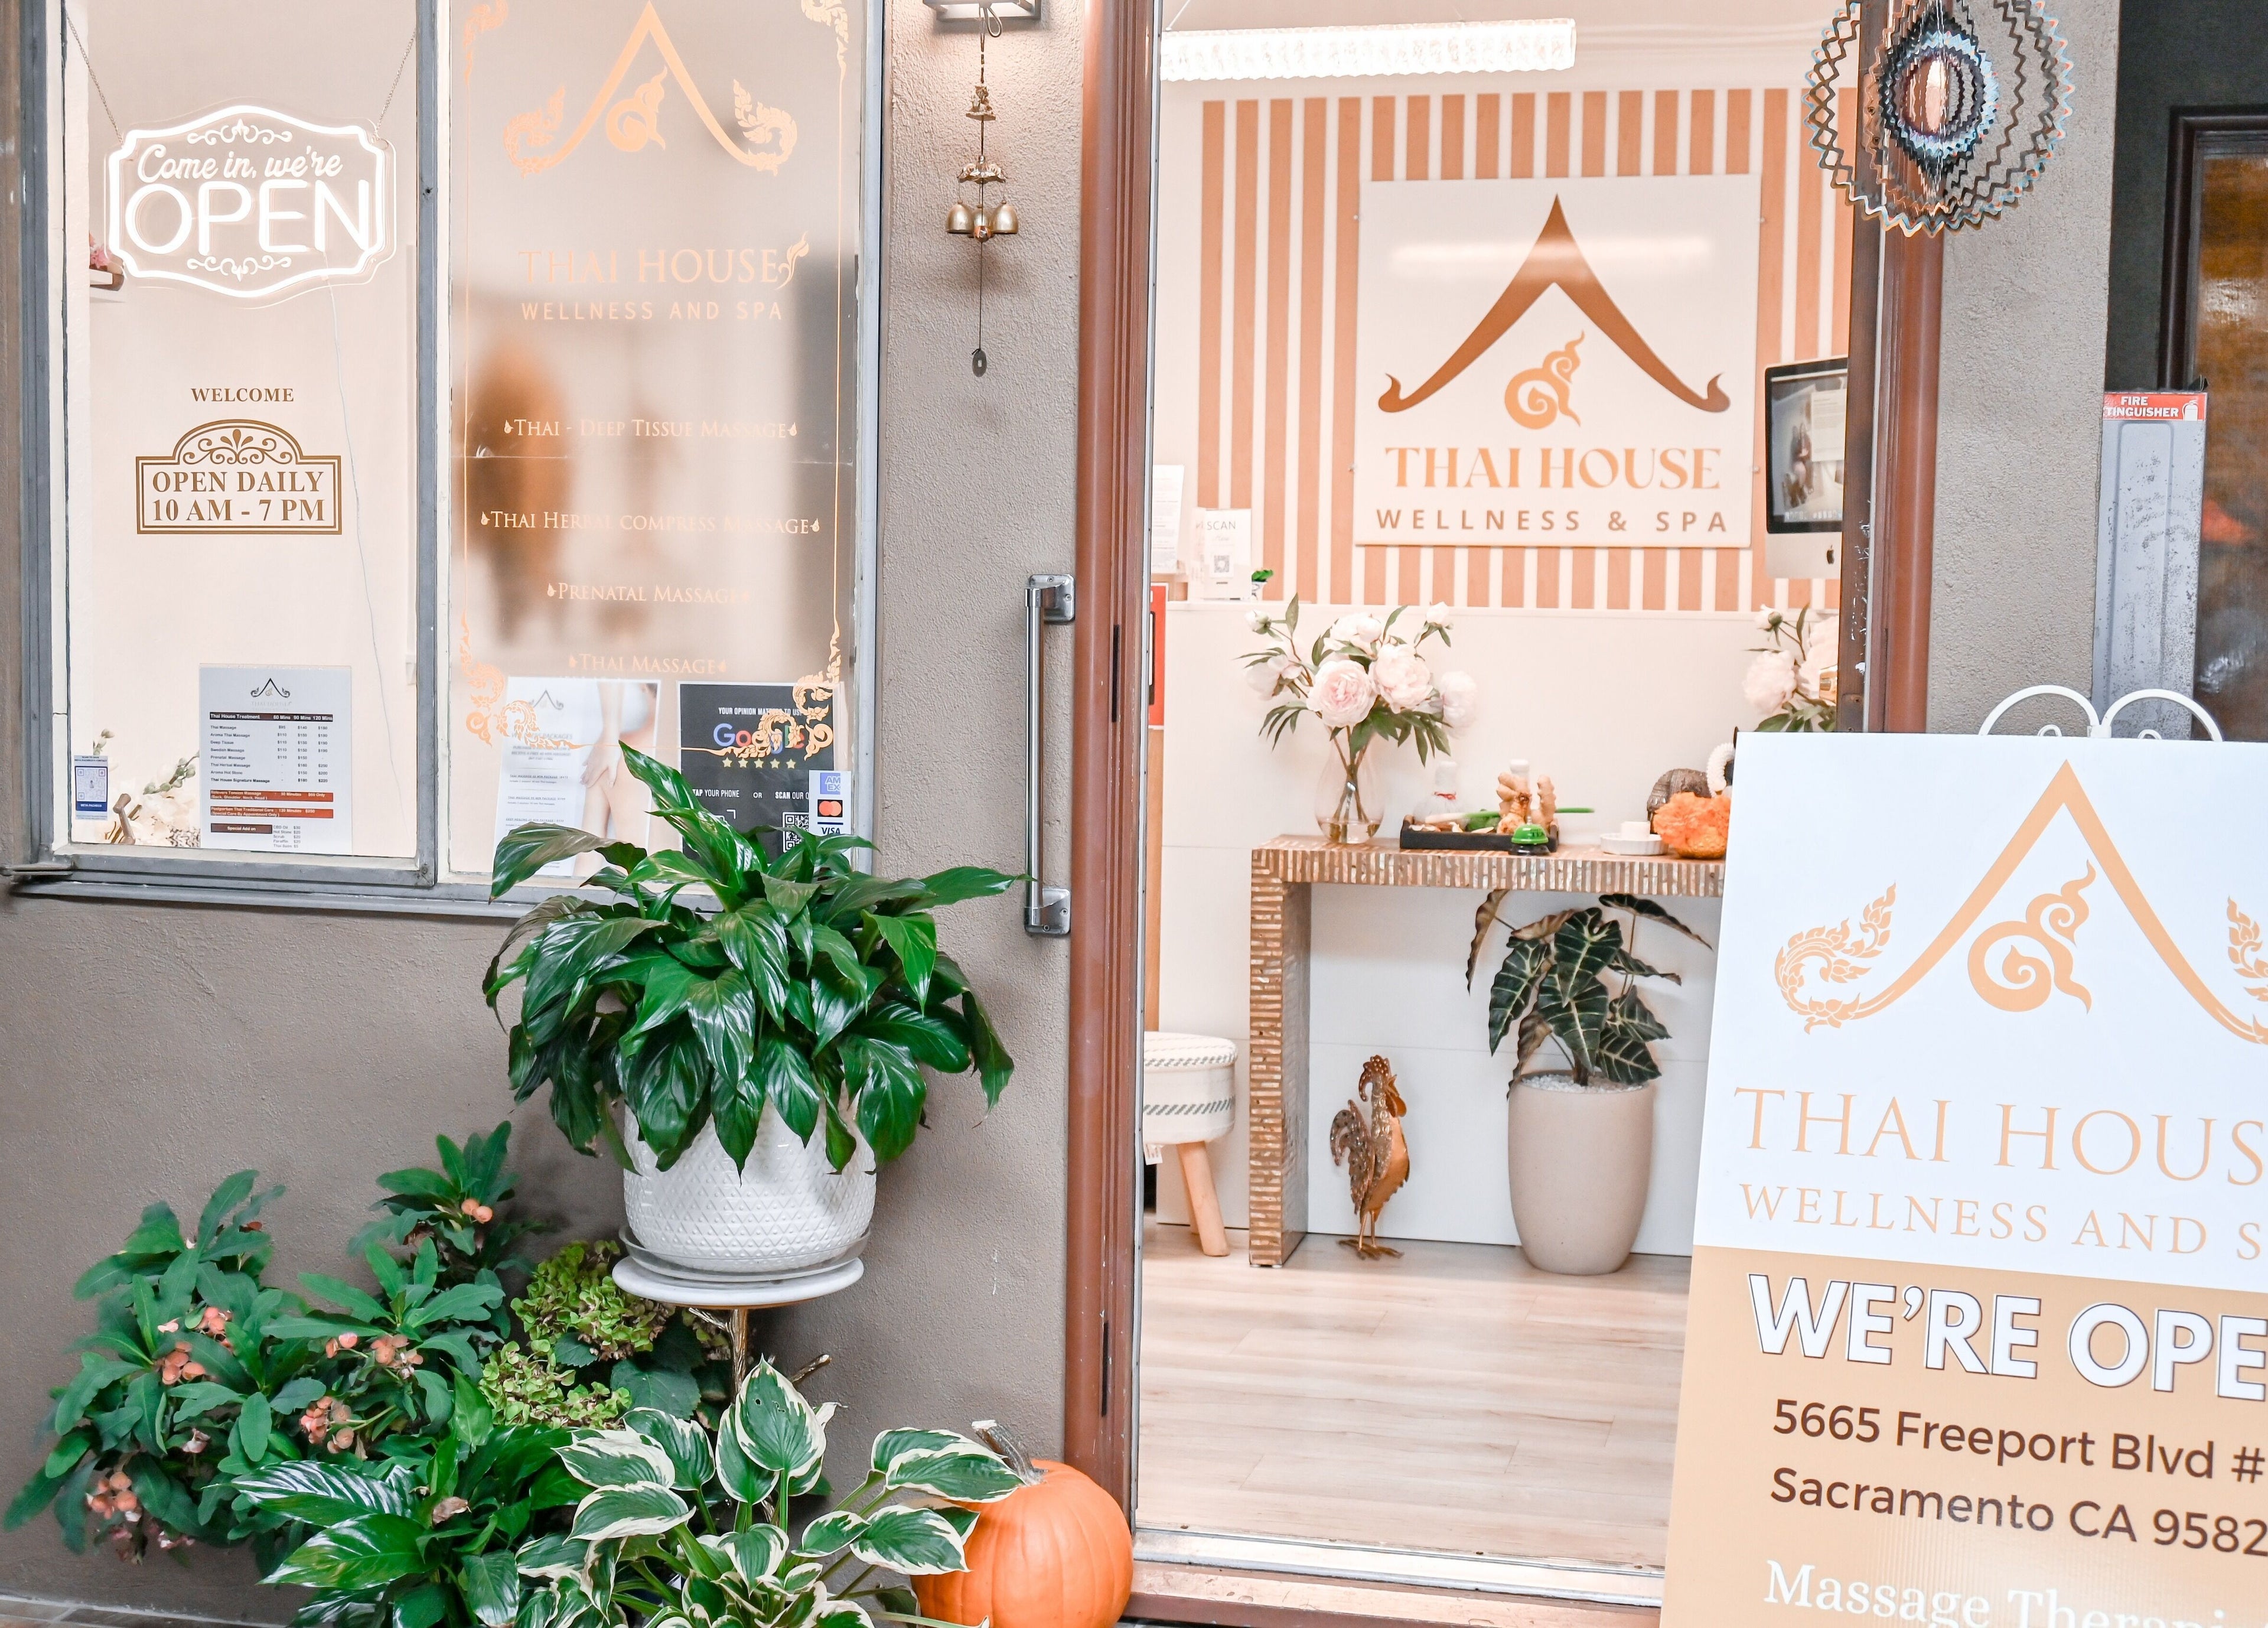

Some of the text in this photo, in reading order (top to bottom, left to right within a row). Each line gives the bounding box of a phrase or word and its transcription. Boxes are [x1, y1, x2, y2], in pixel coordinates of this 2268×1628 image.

[138, 144, 344, 183] Come in, we're
[125, 180, 370, 255] OPEN
[518, 248, 778, 284] THAI HOUSE
[522, 302, 782, 320] WELLNESS AND SPA
[191, 388, 294, 402] WELCOME
[2120, 396, 2149, 406] FIRE
[152, 471, 324, 493] OPEN DAILY
[1385, 447, 1722, 489] THAI HOUSE
[152, 499, 178, 521] 10
[186, 499, 233, 521] AM
[259, 499, 272, 521] 7
[281, 499, 325, 521] PM
[1207, 520, 1236, 531] SCAN
[1376, 509, 1728, 533] WELLNESS & SPA
[734, 707, 757, 715] OPINION
[1734, 1087, 1953, 1163] THAI
[1739, 1183, 2048, 1242] WELLNESS
[2071, 1209, 2207, 1254] AND
[1748, 1273, 2042, 1379] WE'RE
[1772, 1398, 2266, 1484] 5665 Freeport Blvd #
[1771, 1467, 2268, 1557] Sacramento CA 9582
[1763, 1559, 1991, 1628] Massage
